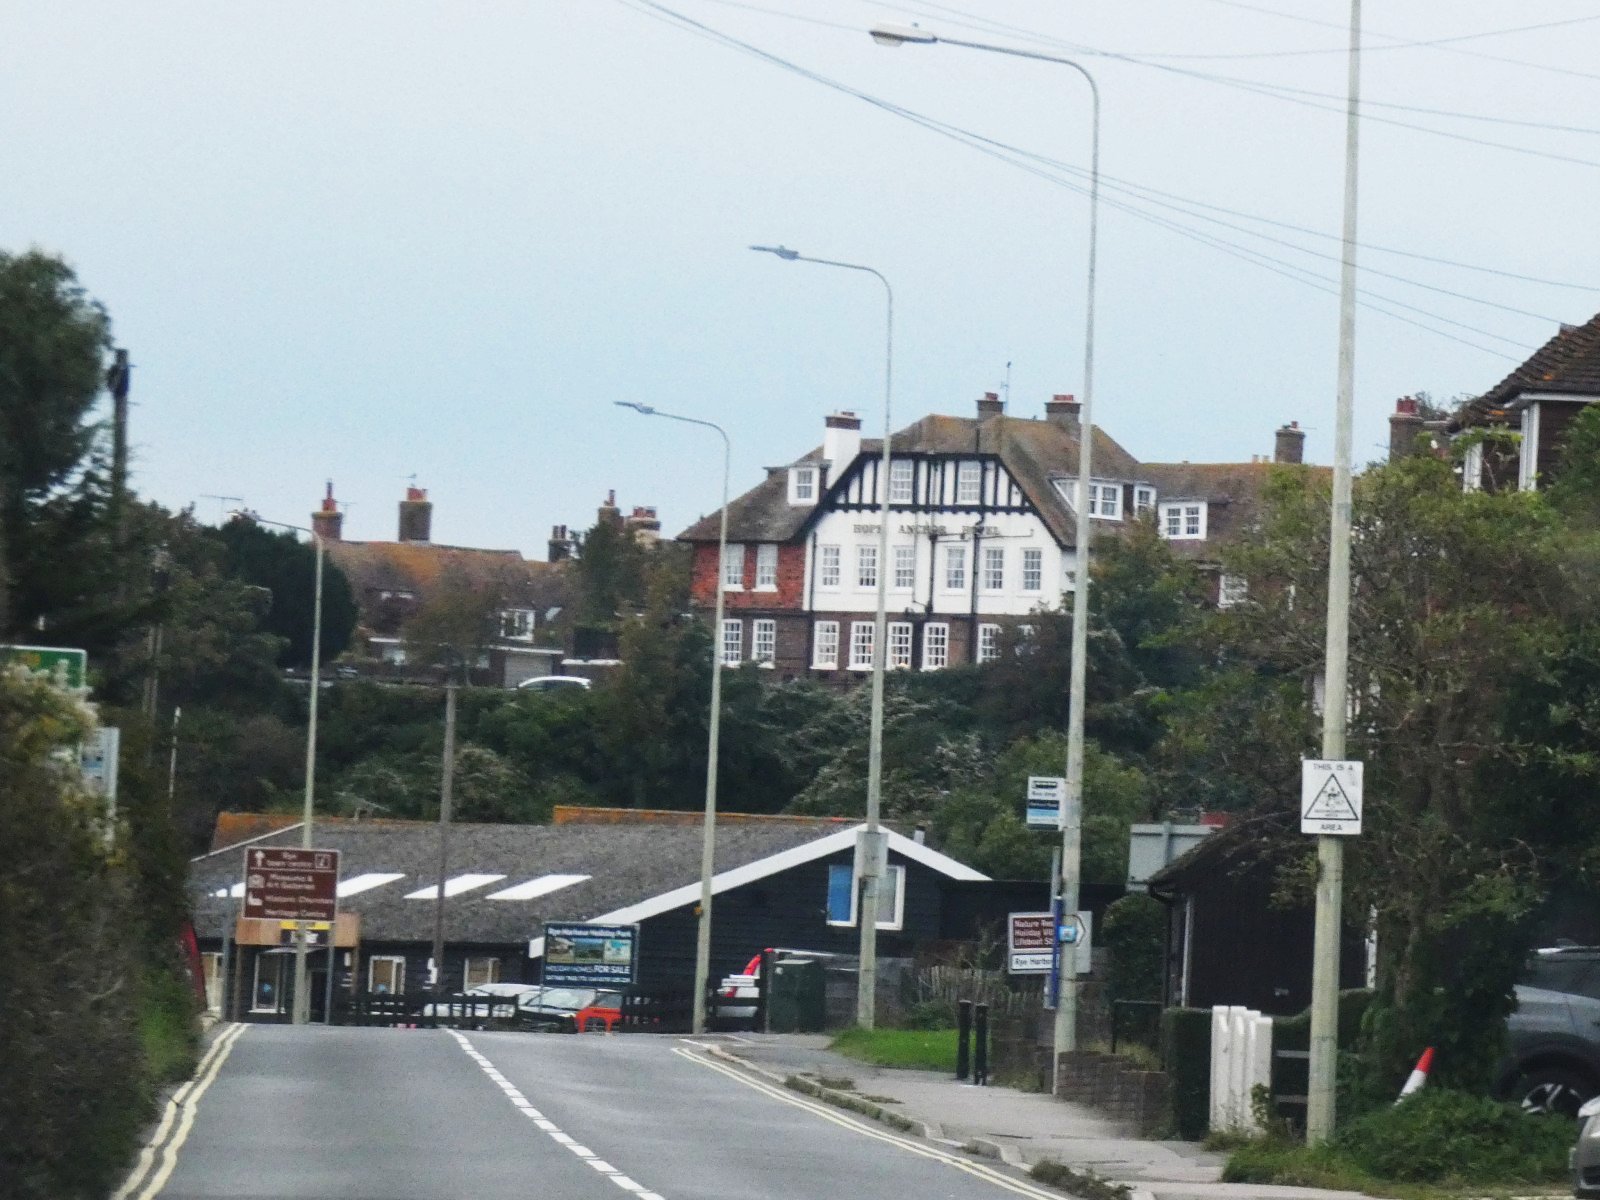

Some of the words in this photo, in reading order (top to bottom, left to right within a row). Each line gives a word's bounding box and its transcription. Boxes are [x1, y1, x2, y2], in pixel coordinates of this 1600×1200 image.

[962, 525, 1000, 535] HOEL
[1321, 823, 1343, 831] AREA
[1014, 920, 1040, 928] Nature
[1014, 929, 1041, 938] Holiday
[1014, 938, 1043, 946] Lifeboat
[1015, 958, 1028, 967] Rye
[1030, 958, 1053, 966] Harbo
[594, 965, 609, 974] FOR
[610, 966, 631, 975] SALE
